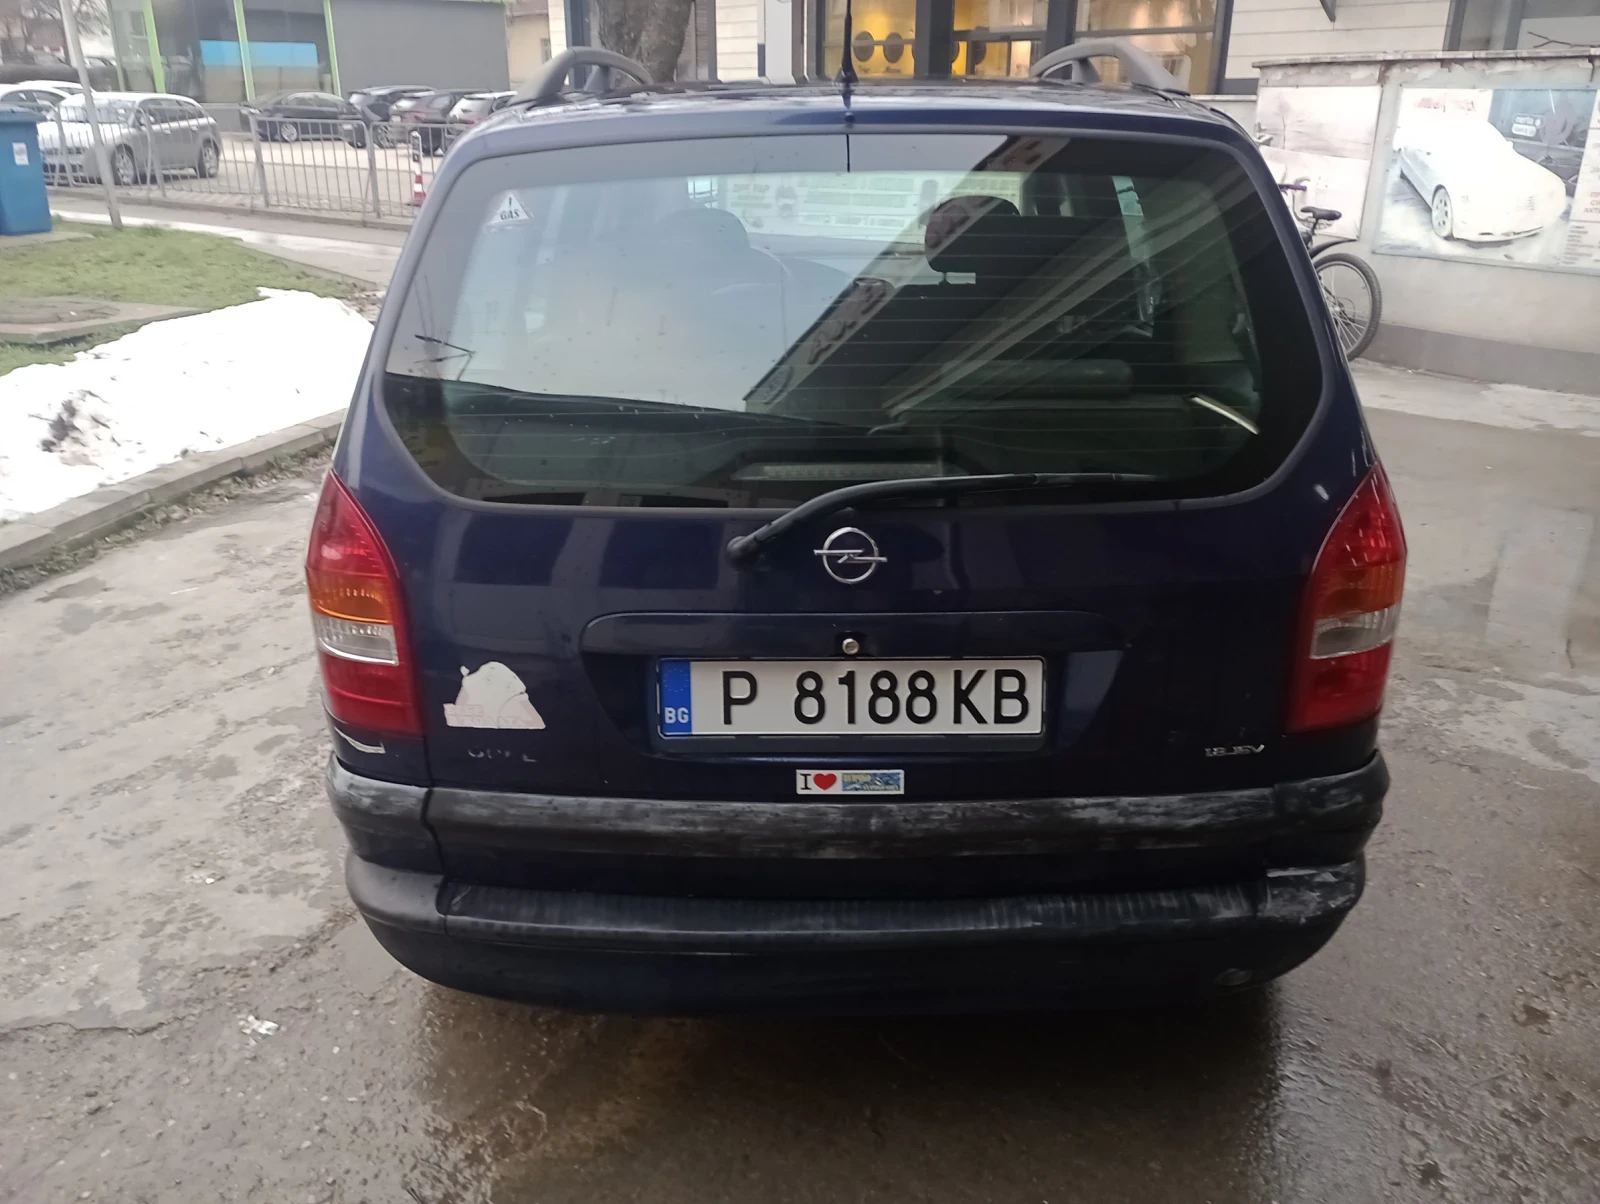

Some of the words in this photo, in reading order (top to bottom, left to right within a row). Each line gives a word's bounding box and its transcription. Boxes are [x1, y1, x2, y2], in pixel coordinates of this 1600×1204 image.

[500, 208, 520, 220] GAS
[722, 670, 758, 725] P
[794, 669, 938, 725] 8188
[664, 707, 689, 724] BG
[799, 773, 812, 790] I
